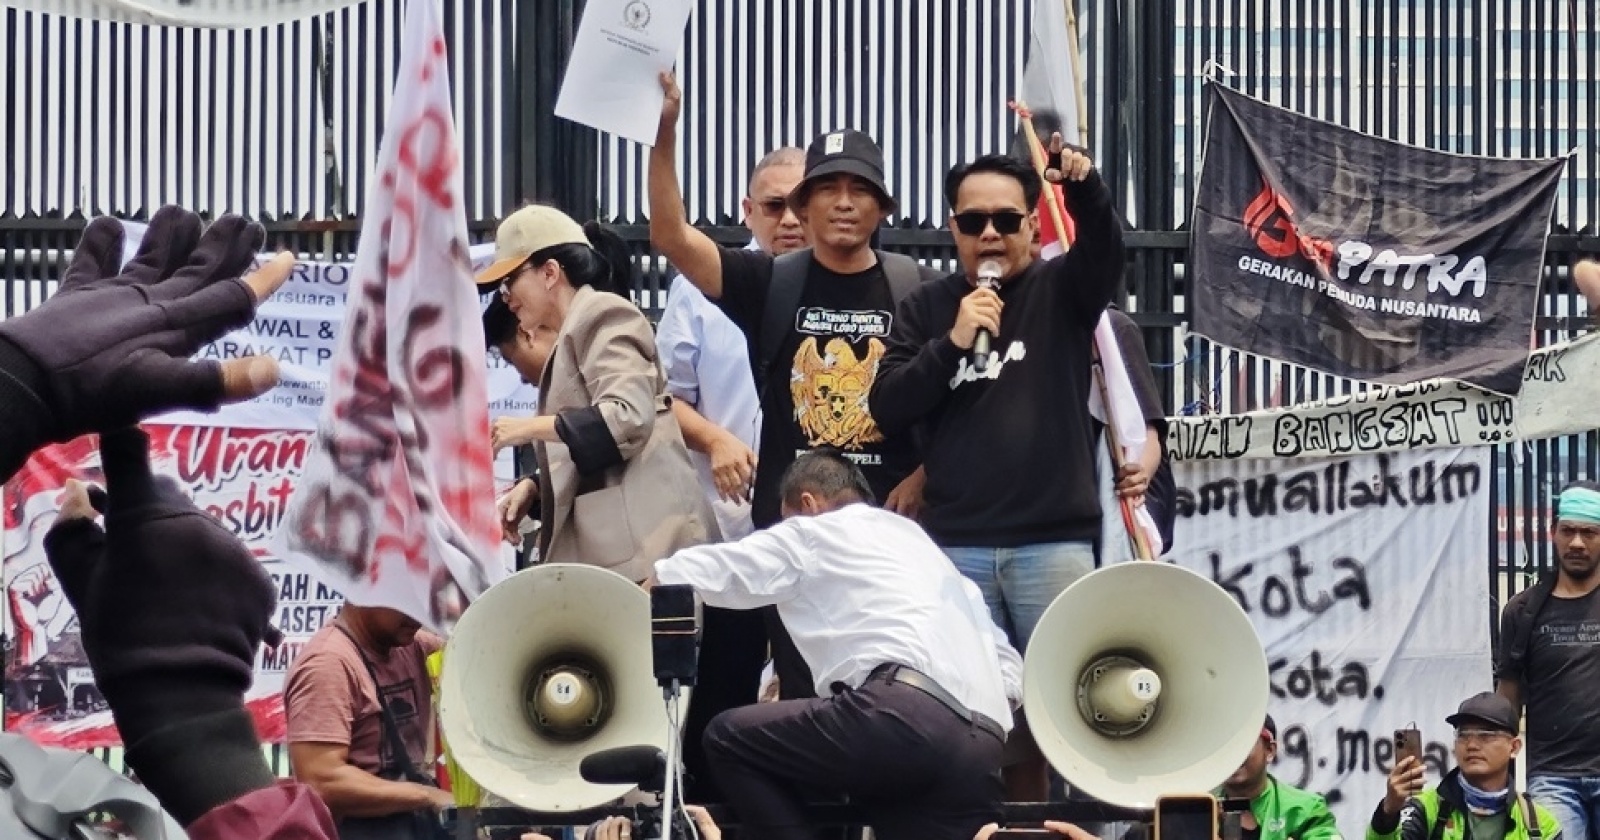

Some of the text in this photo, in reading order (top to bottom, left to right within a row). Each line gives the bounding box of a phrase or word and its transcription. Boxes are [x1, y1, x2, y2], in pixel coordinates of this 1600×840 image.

[1238, 255, 1481, 323] GERAKAN PEMUDA NUSANTARA
[1337, 240, 1487, 298] PATRA
[271, 290, 336, 306] rsuara
[252, 320, 335, 340] WAL &
[273, 395, 294, 408] Ing
[1166, 417, 1253, 461] ATAU
[1273, 398, 1467, 457] BANGSAT
[171, 426, 311, 486] Uran
[279, 606, 328, 632] ASET
